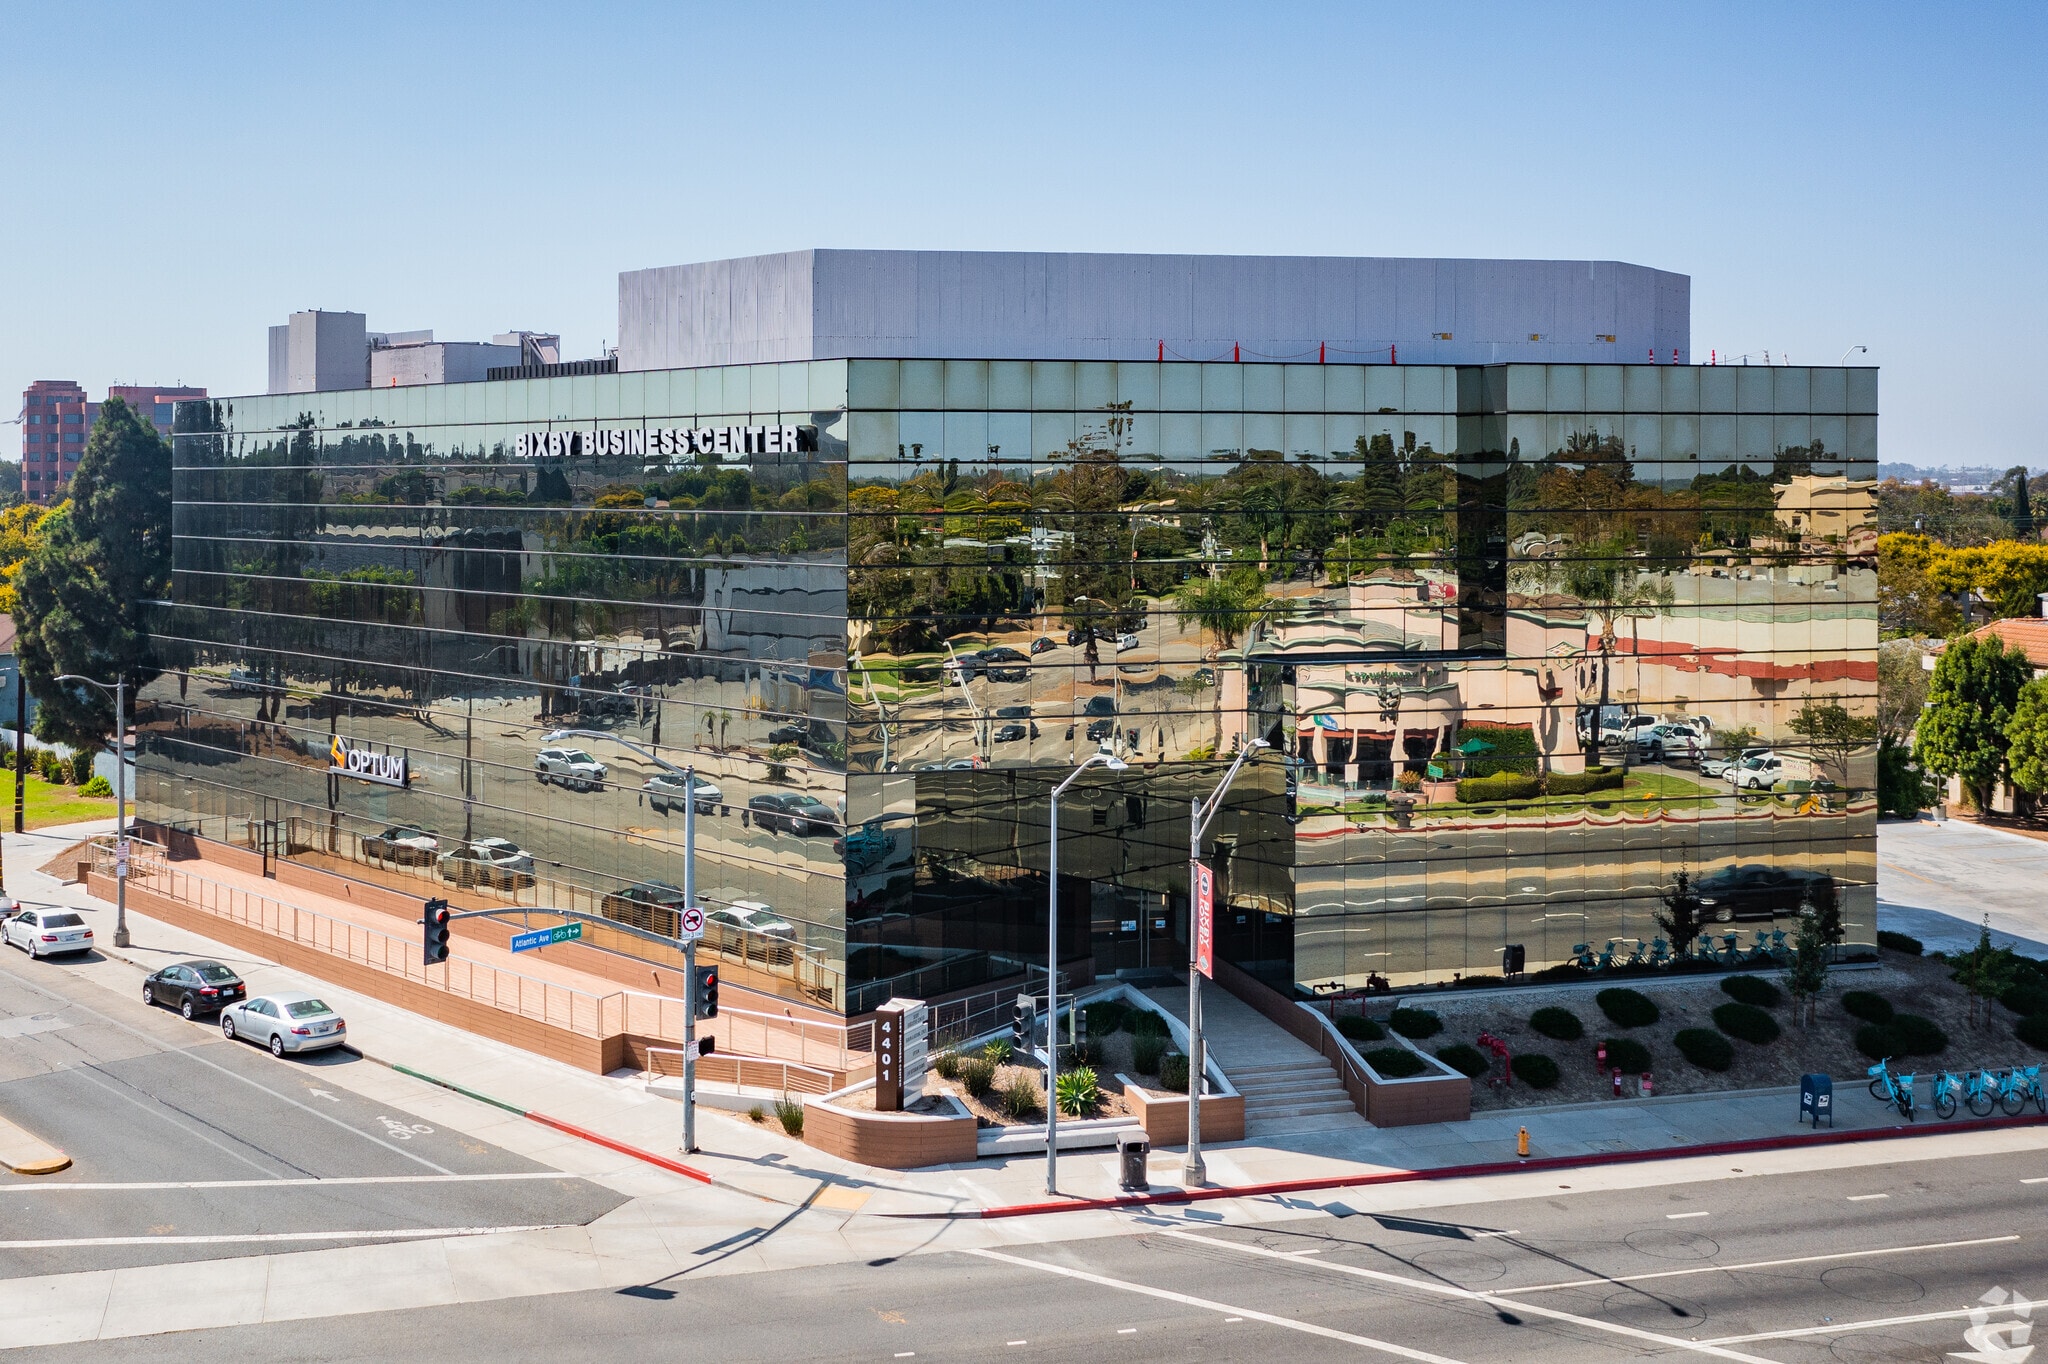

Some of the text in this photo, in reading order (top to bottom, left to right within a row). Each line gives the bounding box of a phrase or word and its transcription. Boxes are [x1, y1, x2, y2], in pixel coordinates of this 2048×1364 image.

[515, 425, 799, 457] BIXBY BUSINESS CENTER
[348, 749, 405, 780] OPTUM
[514, 934, 550, 948] Atlantic Ave
[882, 1022, 891, 1081] 4401
